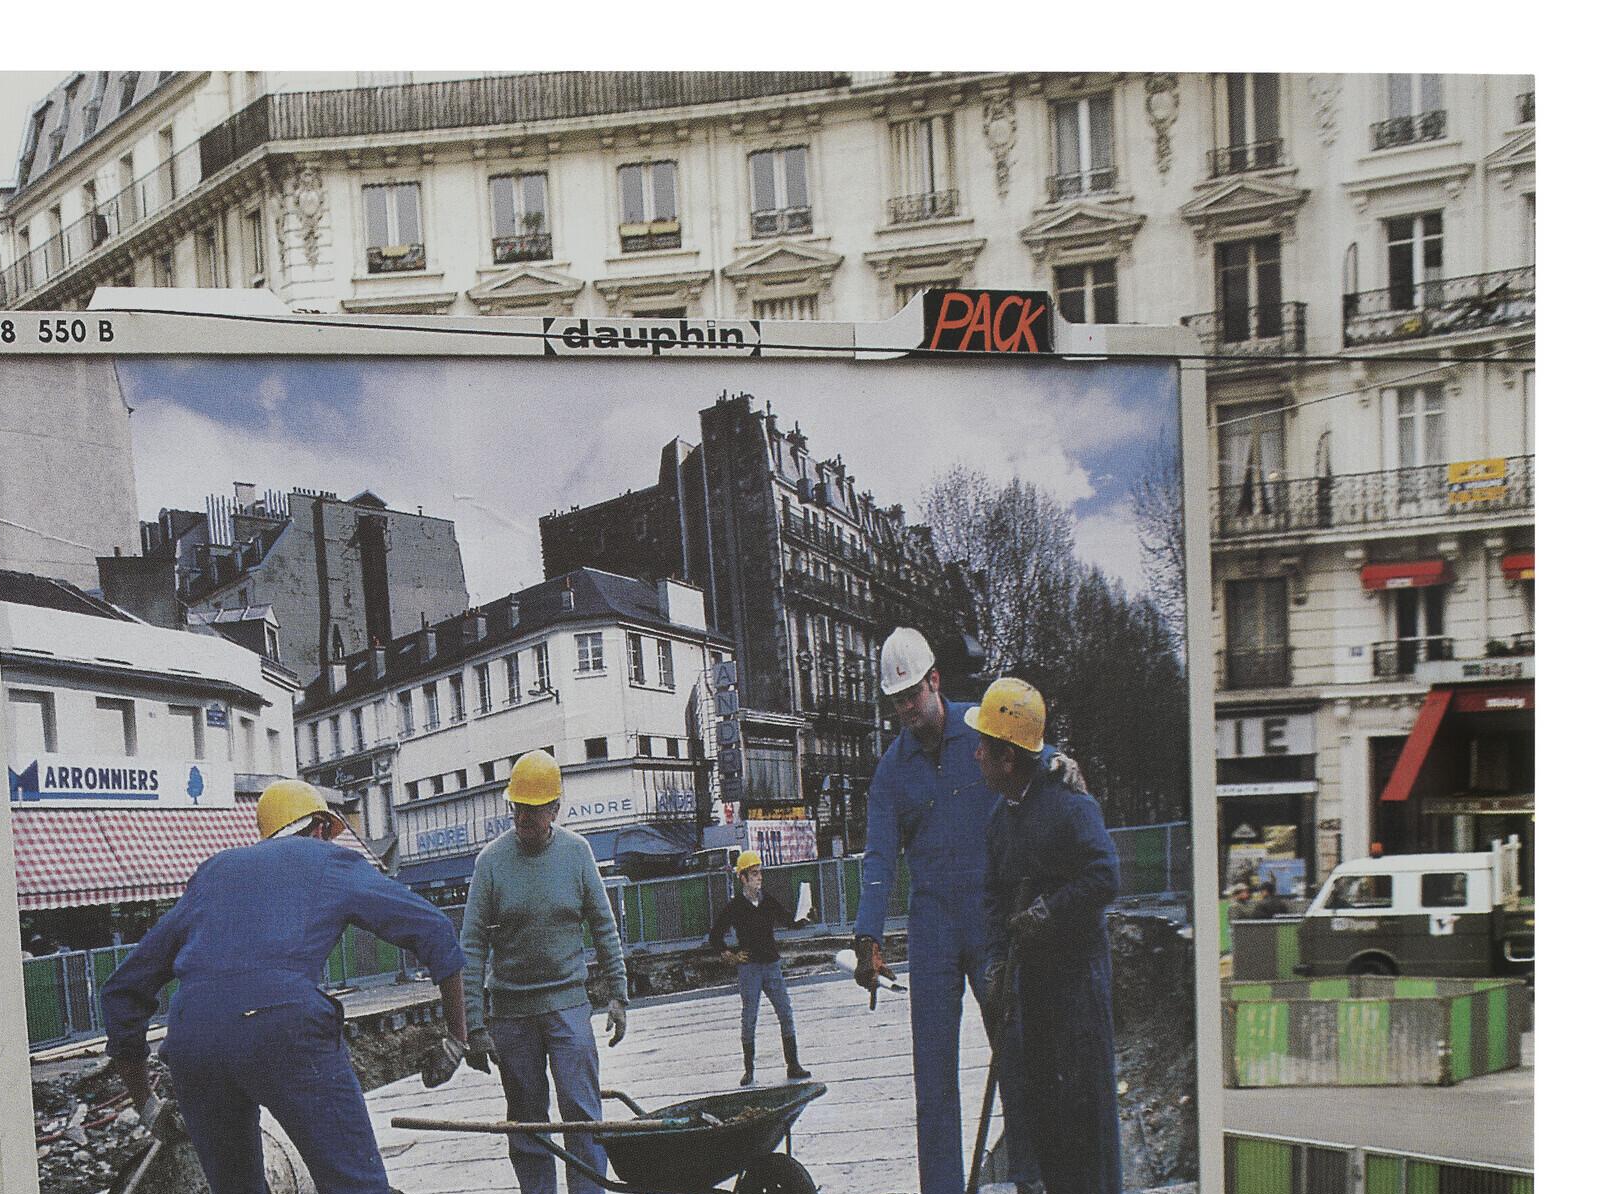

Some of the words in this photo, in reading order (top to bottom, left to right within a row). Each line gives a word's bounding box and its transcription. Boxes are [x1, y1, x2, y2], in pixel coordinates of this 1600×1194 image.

[38, 319, 86, 343] 550
[98, 320, 114, 342] B
[562, 318, 744, 355] dauphin
[929, 291, 1046, 352] PACK
